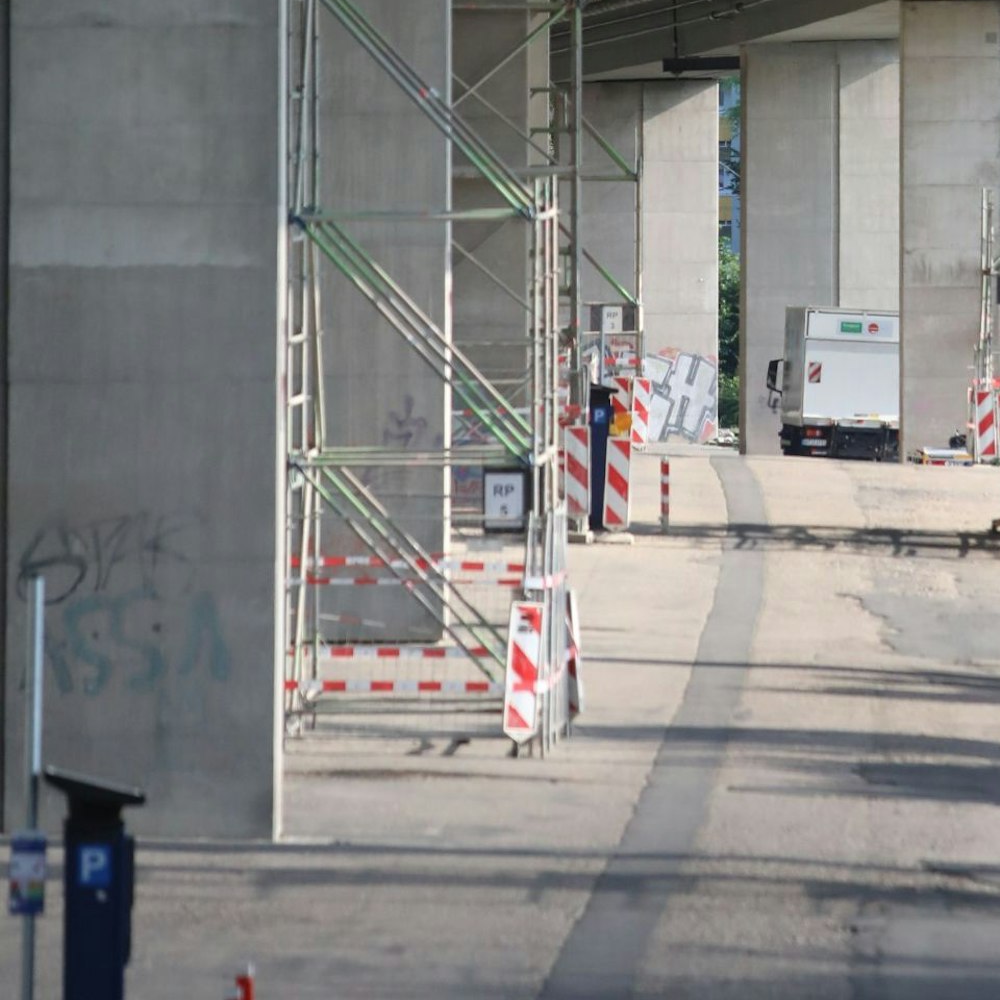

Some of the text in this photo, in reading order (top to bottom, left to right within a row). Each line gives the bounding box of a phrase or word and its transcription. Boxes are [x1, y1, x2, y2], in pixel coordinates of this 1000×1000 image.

[595, 408, 605, 423] P
[493, 483, 514, 497] RP
[81, 848, 107, 883] P
